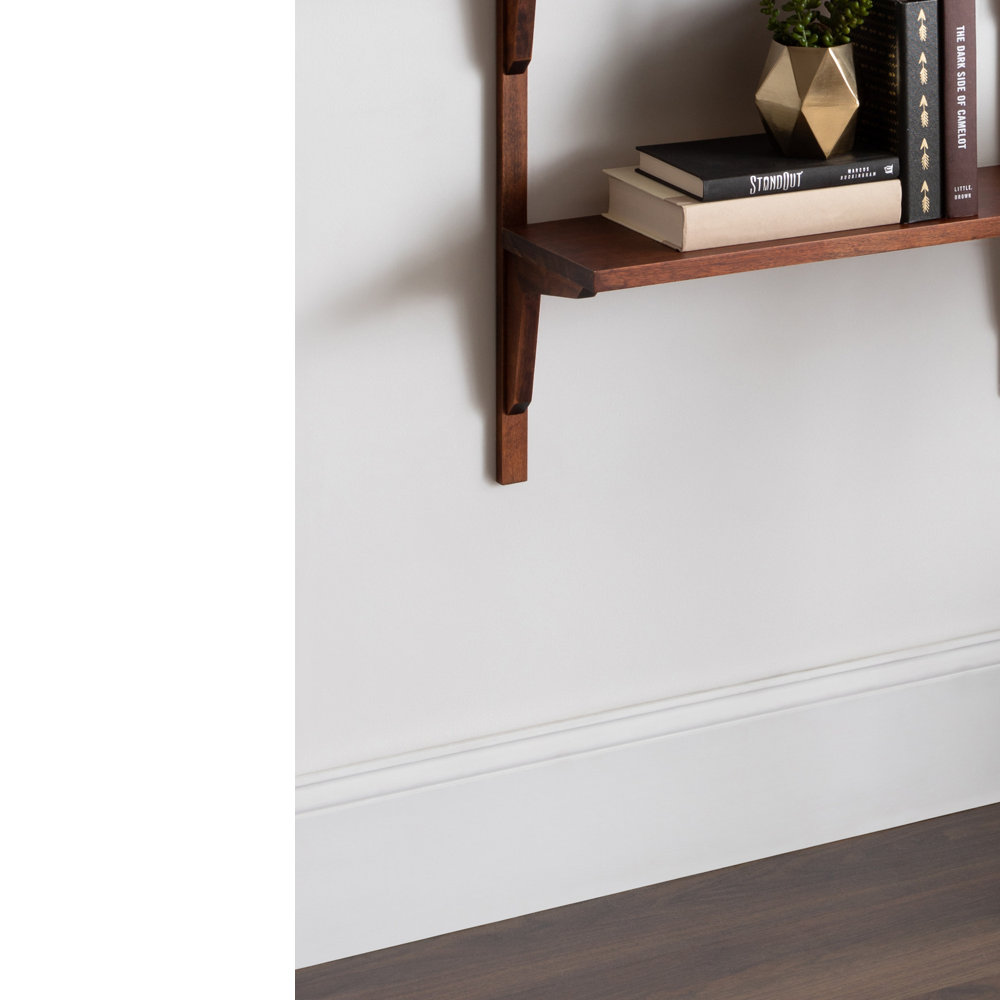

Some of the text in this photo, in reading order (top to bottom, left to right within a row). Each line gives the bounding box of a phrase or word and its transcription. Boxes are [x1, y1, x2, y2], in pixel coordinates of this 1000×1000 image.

[956, 25, 967, 150] THE DARK SIDE OF CAMELOT
